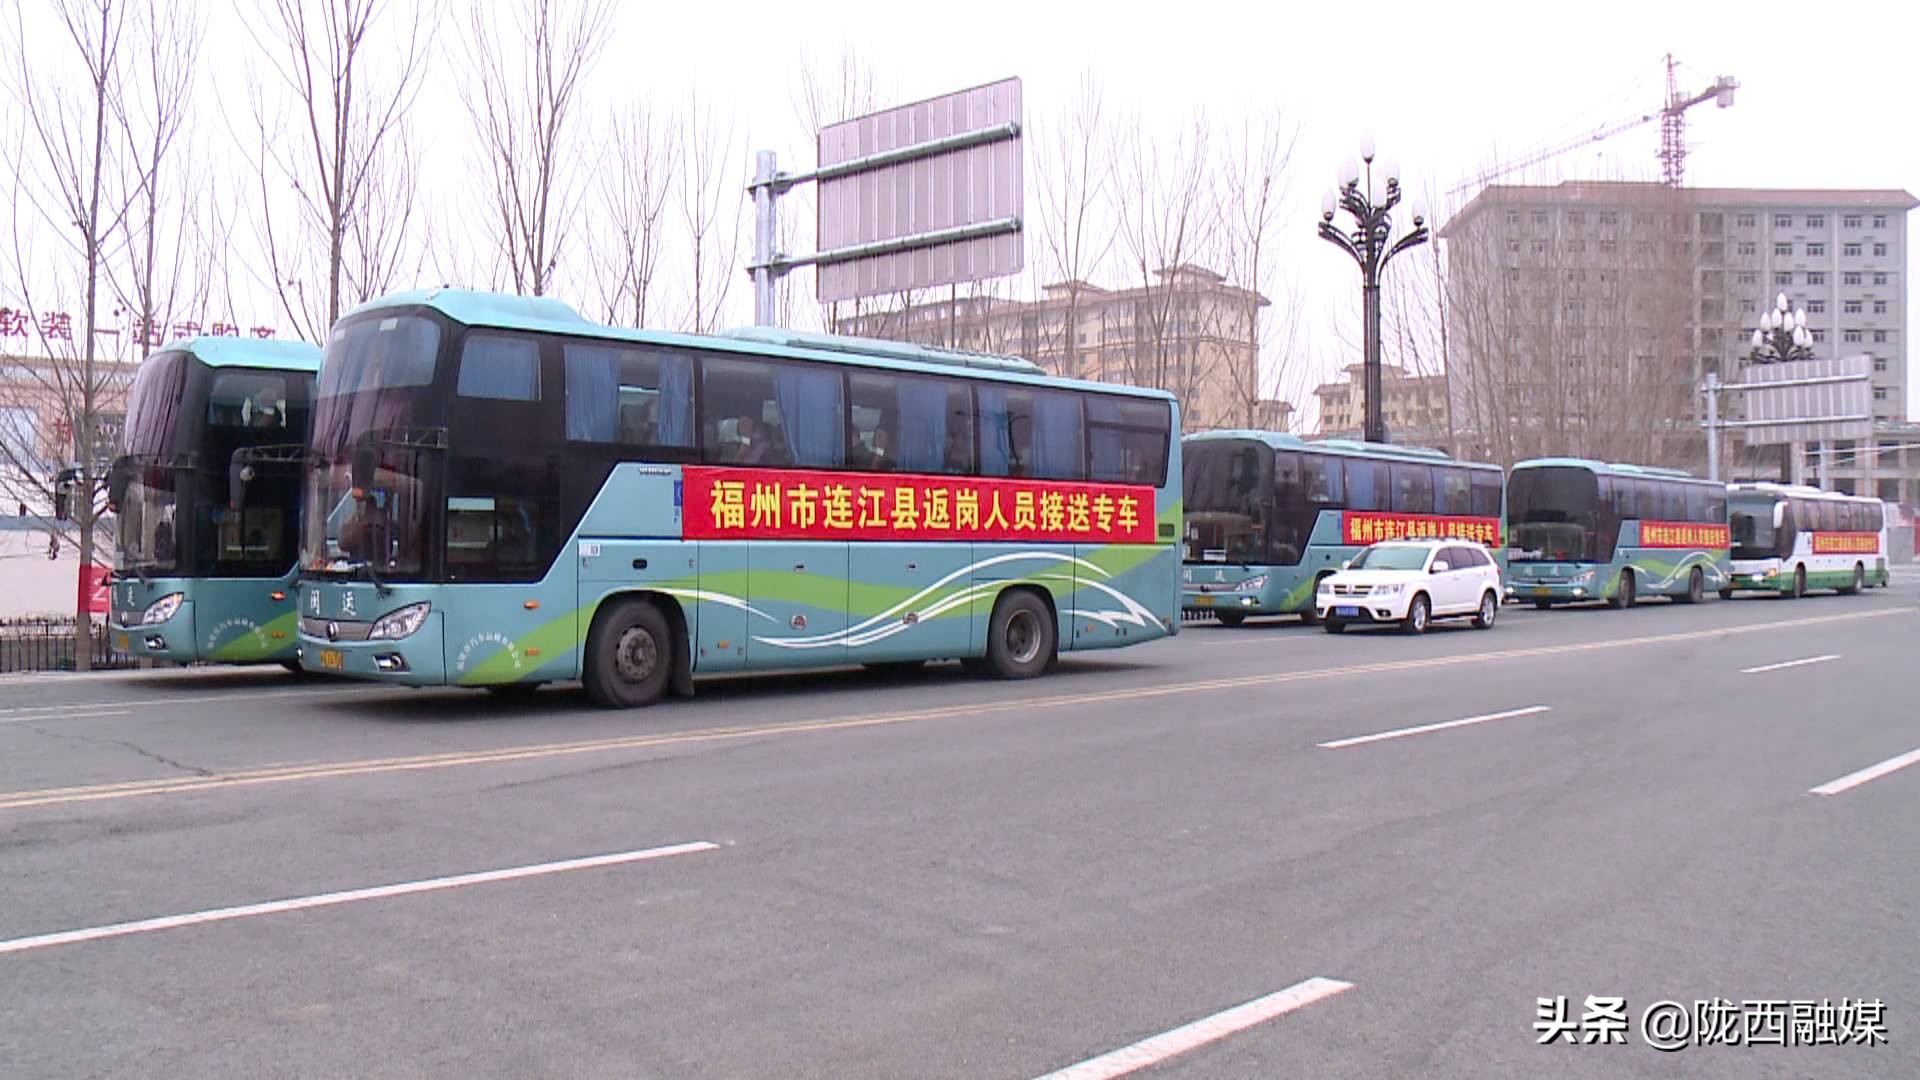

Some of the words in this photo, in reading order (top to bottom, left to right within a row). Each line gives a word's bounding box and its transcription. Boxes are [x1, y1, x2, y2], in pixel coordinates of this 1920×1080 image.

[710, 479, 1139, 534] 福州市连江县返岗人员接送专车
